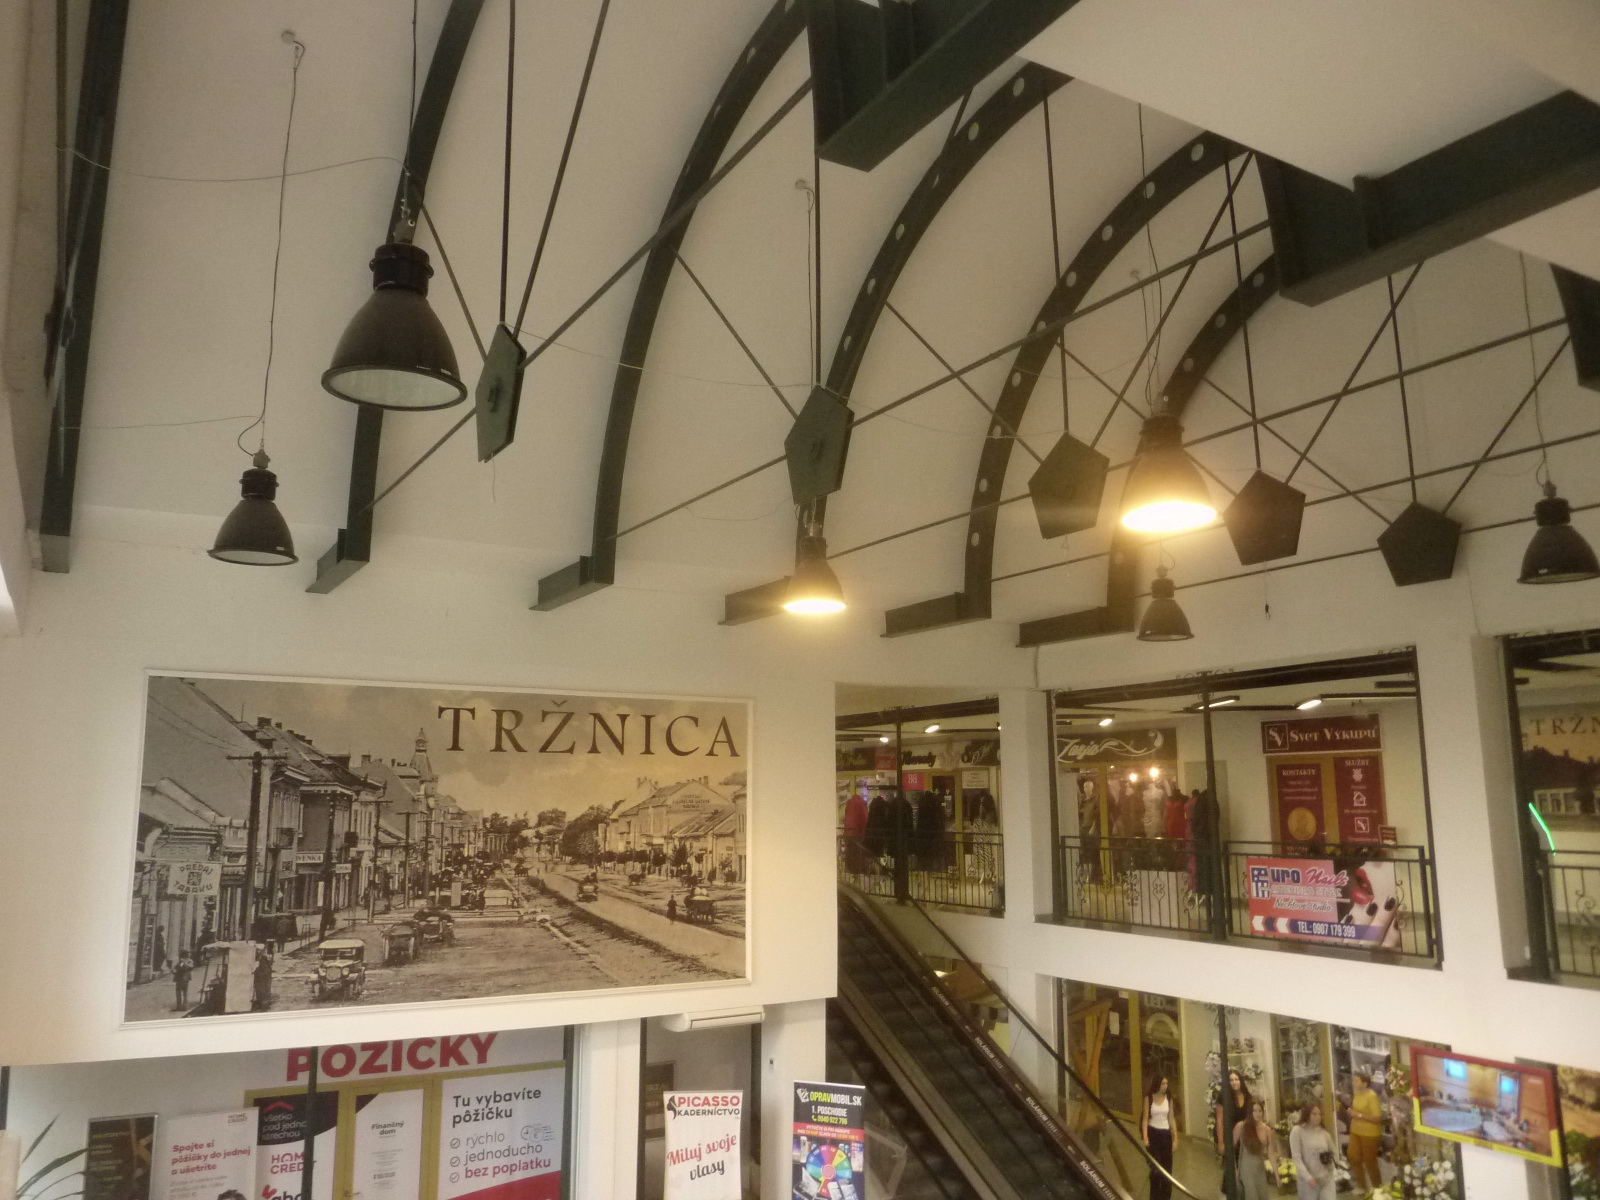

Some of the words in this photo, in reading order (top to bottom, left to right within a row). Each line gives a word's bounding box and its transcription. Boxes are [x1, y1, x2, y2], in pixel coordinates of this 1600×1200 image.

[438, 700, 740, 757] TRŽNICA
[1313, 922, 1328, 935] 0907
[1330, 924, 1342, 936] 179
[1342, 925, 1355, 937] 399
[453, 1095, 470, 1108] Tu
[476, 1087, 541, 1108] vybavíte
[677, 1095, 740, 1107] PICASSO
[452, 1107, 513, 1128] pôžičku
[677, 1107, 740, 1116] KADERNÍCTVO
[282, 1120, 307, 1131] jedno
[371, 1120, 404, 1130] Finančný
[379, 1128, 396, 1136] dom
[172, 1142, 204, 1153] Spojte
[206, 1139, 215, 1147] si
[465, 1131, 505, 1148] rýchlo
[171, 1153, 208, 1166] pôžičky
[210, 1151, 221, 1159] do
[222, 1146, 252, 1159] jednej
[271, 1152, 305, 1164] HOM
[463, 1143, 543, 1166] jednoducho
[667, 1142, 702, 1166] Miluj
[705, 1134, 737, 1154] svoje
[270, 1161, 305, 1175] CRED
[465, 1167, 488, 1178] bez
[492, 1157, 551, 1178] poplatku
[689, 1160, 725, 1181] vlasy
